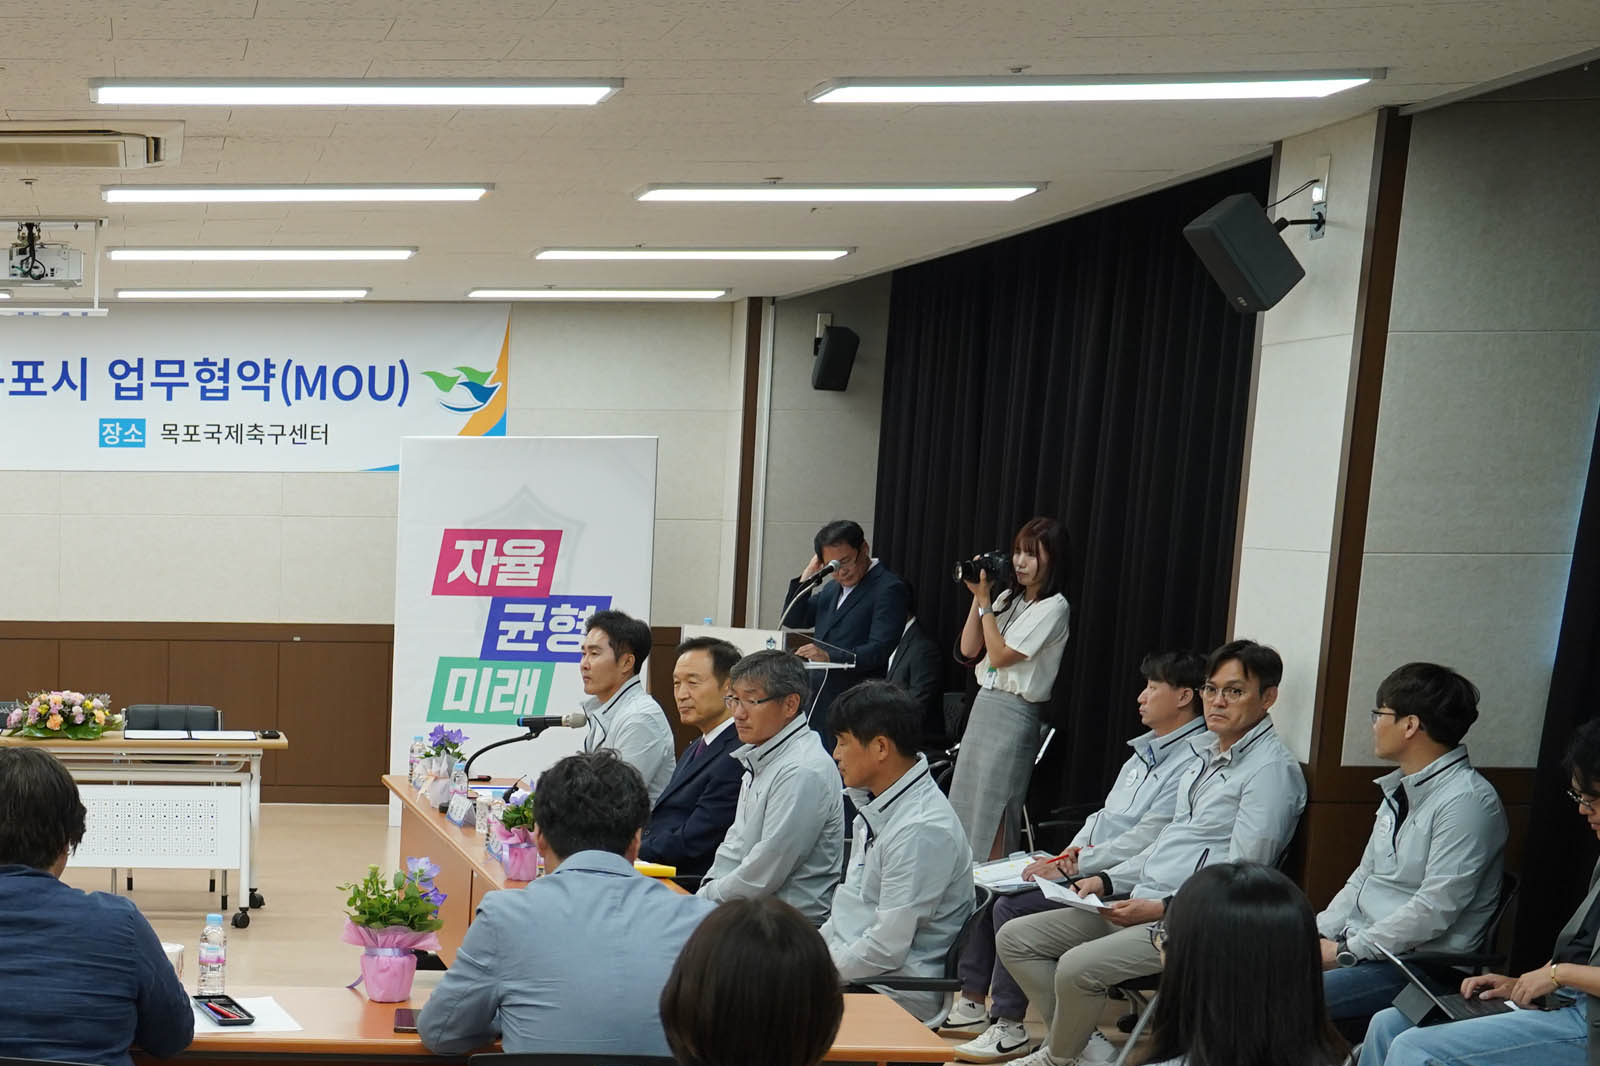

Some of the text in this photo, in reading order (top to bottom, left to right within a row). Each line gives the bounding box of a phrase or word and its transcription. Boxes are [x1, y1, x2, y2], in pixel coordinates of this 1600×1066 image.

[108, 357, 409, 407] 업무협약(MOU)
[101, 422, 144, 446] 장소
[160, 422, 329, 446] 목포국제축구센터
[447, 538, 546, 587] 자율
[496, 603, 596, 653] 균형
[442, 667, 542, 715] 미래
